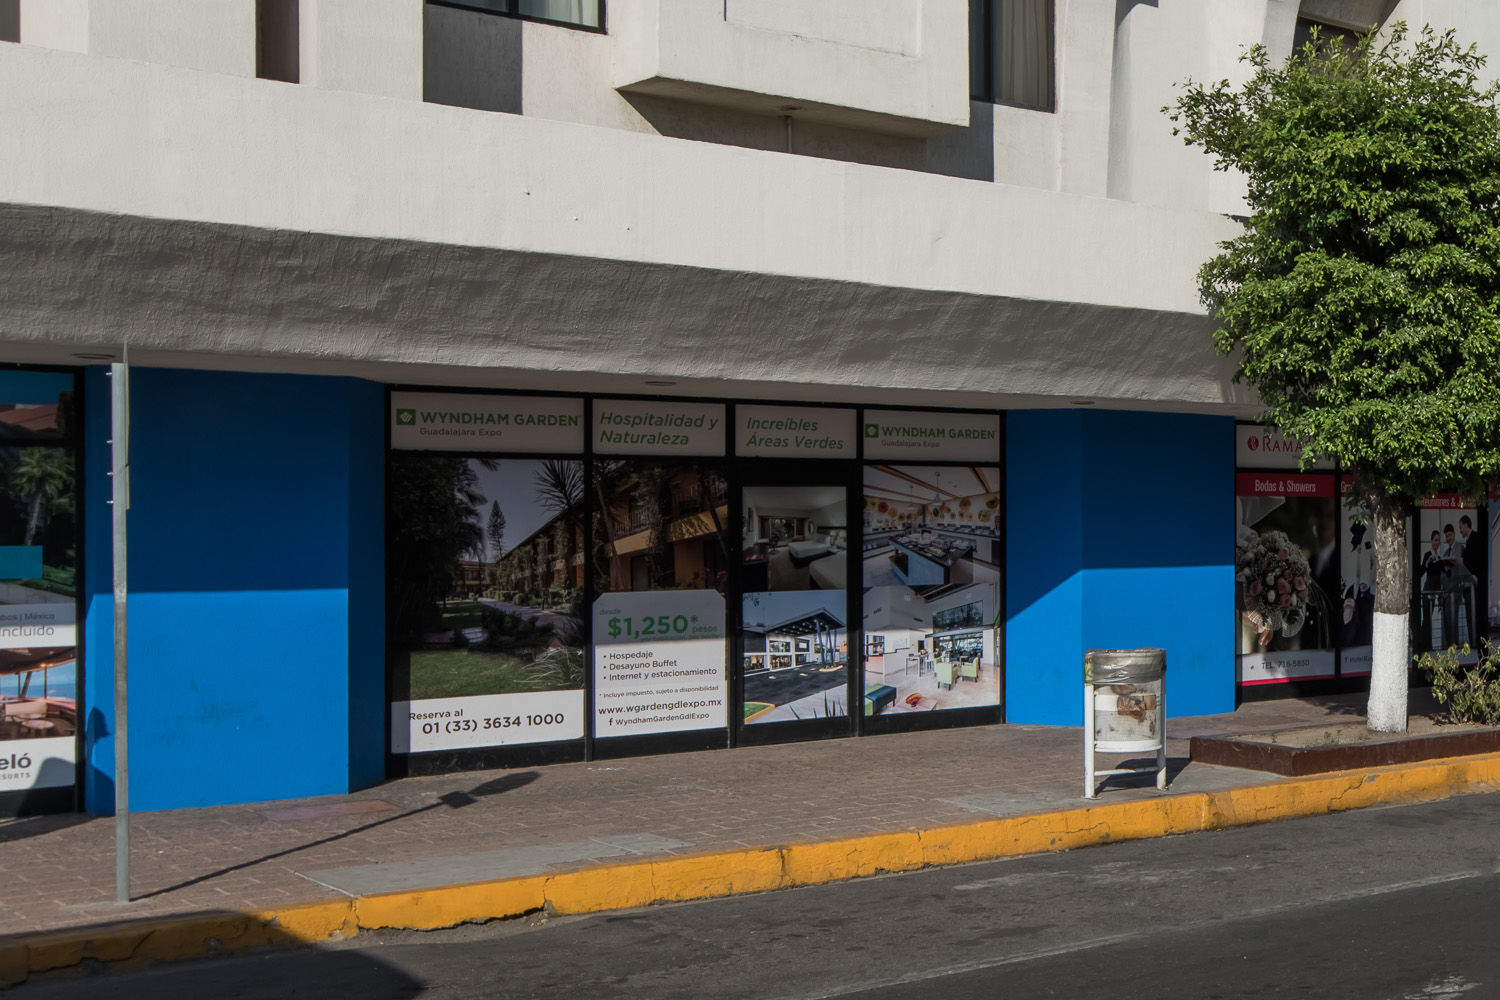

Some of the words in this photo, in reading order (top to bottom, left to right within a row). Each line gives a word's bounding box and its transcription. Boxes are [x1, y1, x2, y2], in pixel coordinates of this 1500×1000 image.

[420, 411, 509, 425] WYNDHAM
[514, 414, 578, 427] GARDEN
[600, 411, 705, 428] Hospitalidad
[707, 418, 720, 431] y
[746, 417, 819, 432] Increíbles
[419, 427, 476, 438] Guadalajara
[478, 428, 503, 438] Expo
[600, 430, 690, 446] Naturaleza
[881, 426, 945, 439] WYNDHAM
[948, 429, 996, 441] GARDEN
[745, 431, 789, 449] Áreas
[795, 435, 845, 450] Verdes
[1255, 480, 1277, 492] Bodas
[1286, 480, 1316, 493] Showers
[609, 651, 653, 661] Hospedaje
[609, 661, 651, 672] Desayuno
[652, 659, 677, 669] Buffet
[609, 671, 642, 682] Internet
[644, 672, 650, 681] y
[651, 667, 718, 679] estacionamiento
[625, 689, 655, 698] impuesto,
[656, 688, 674, 697] sujeto
[679, 685, 719, 694] disponibilidad
[598, 699, 723, 715] www.wgardengdlexpo.mx
[409, 711, 451, 721] Reserva
[454, 709, 464, 718] al
[615, 711, 710, 727] WyndhamGardenGdlExpo
[422, 722, 439, 735] 01
[445, 719, 478, 734] (33)
[483, 715, 522, 730] 3634
[526, 712, 565, 727] 1000
